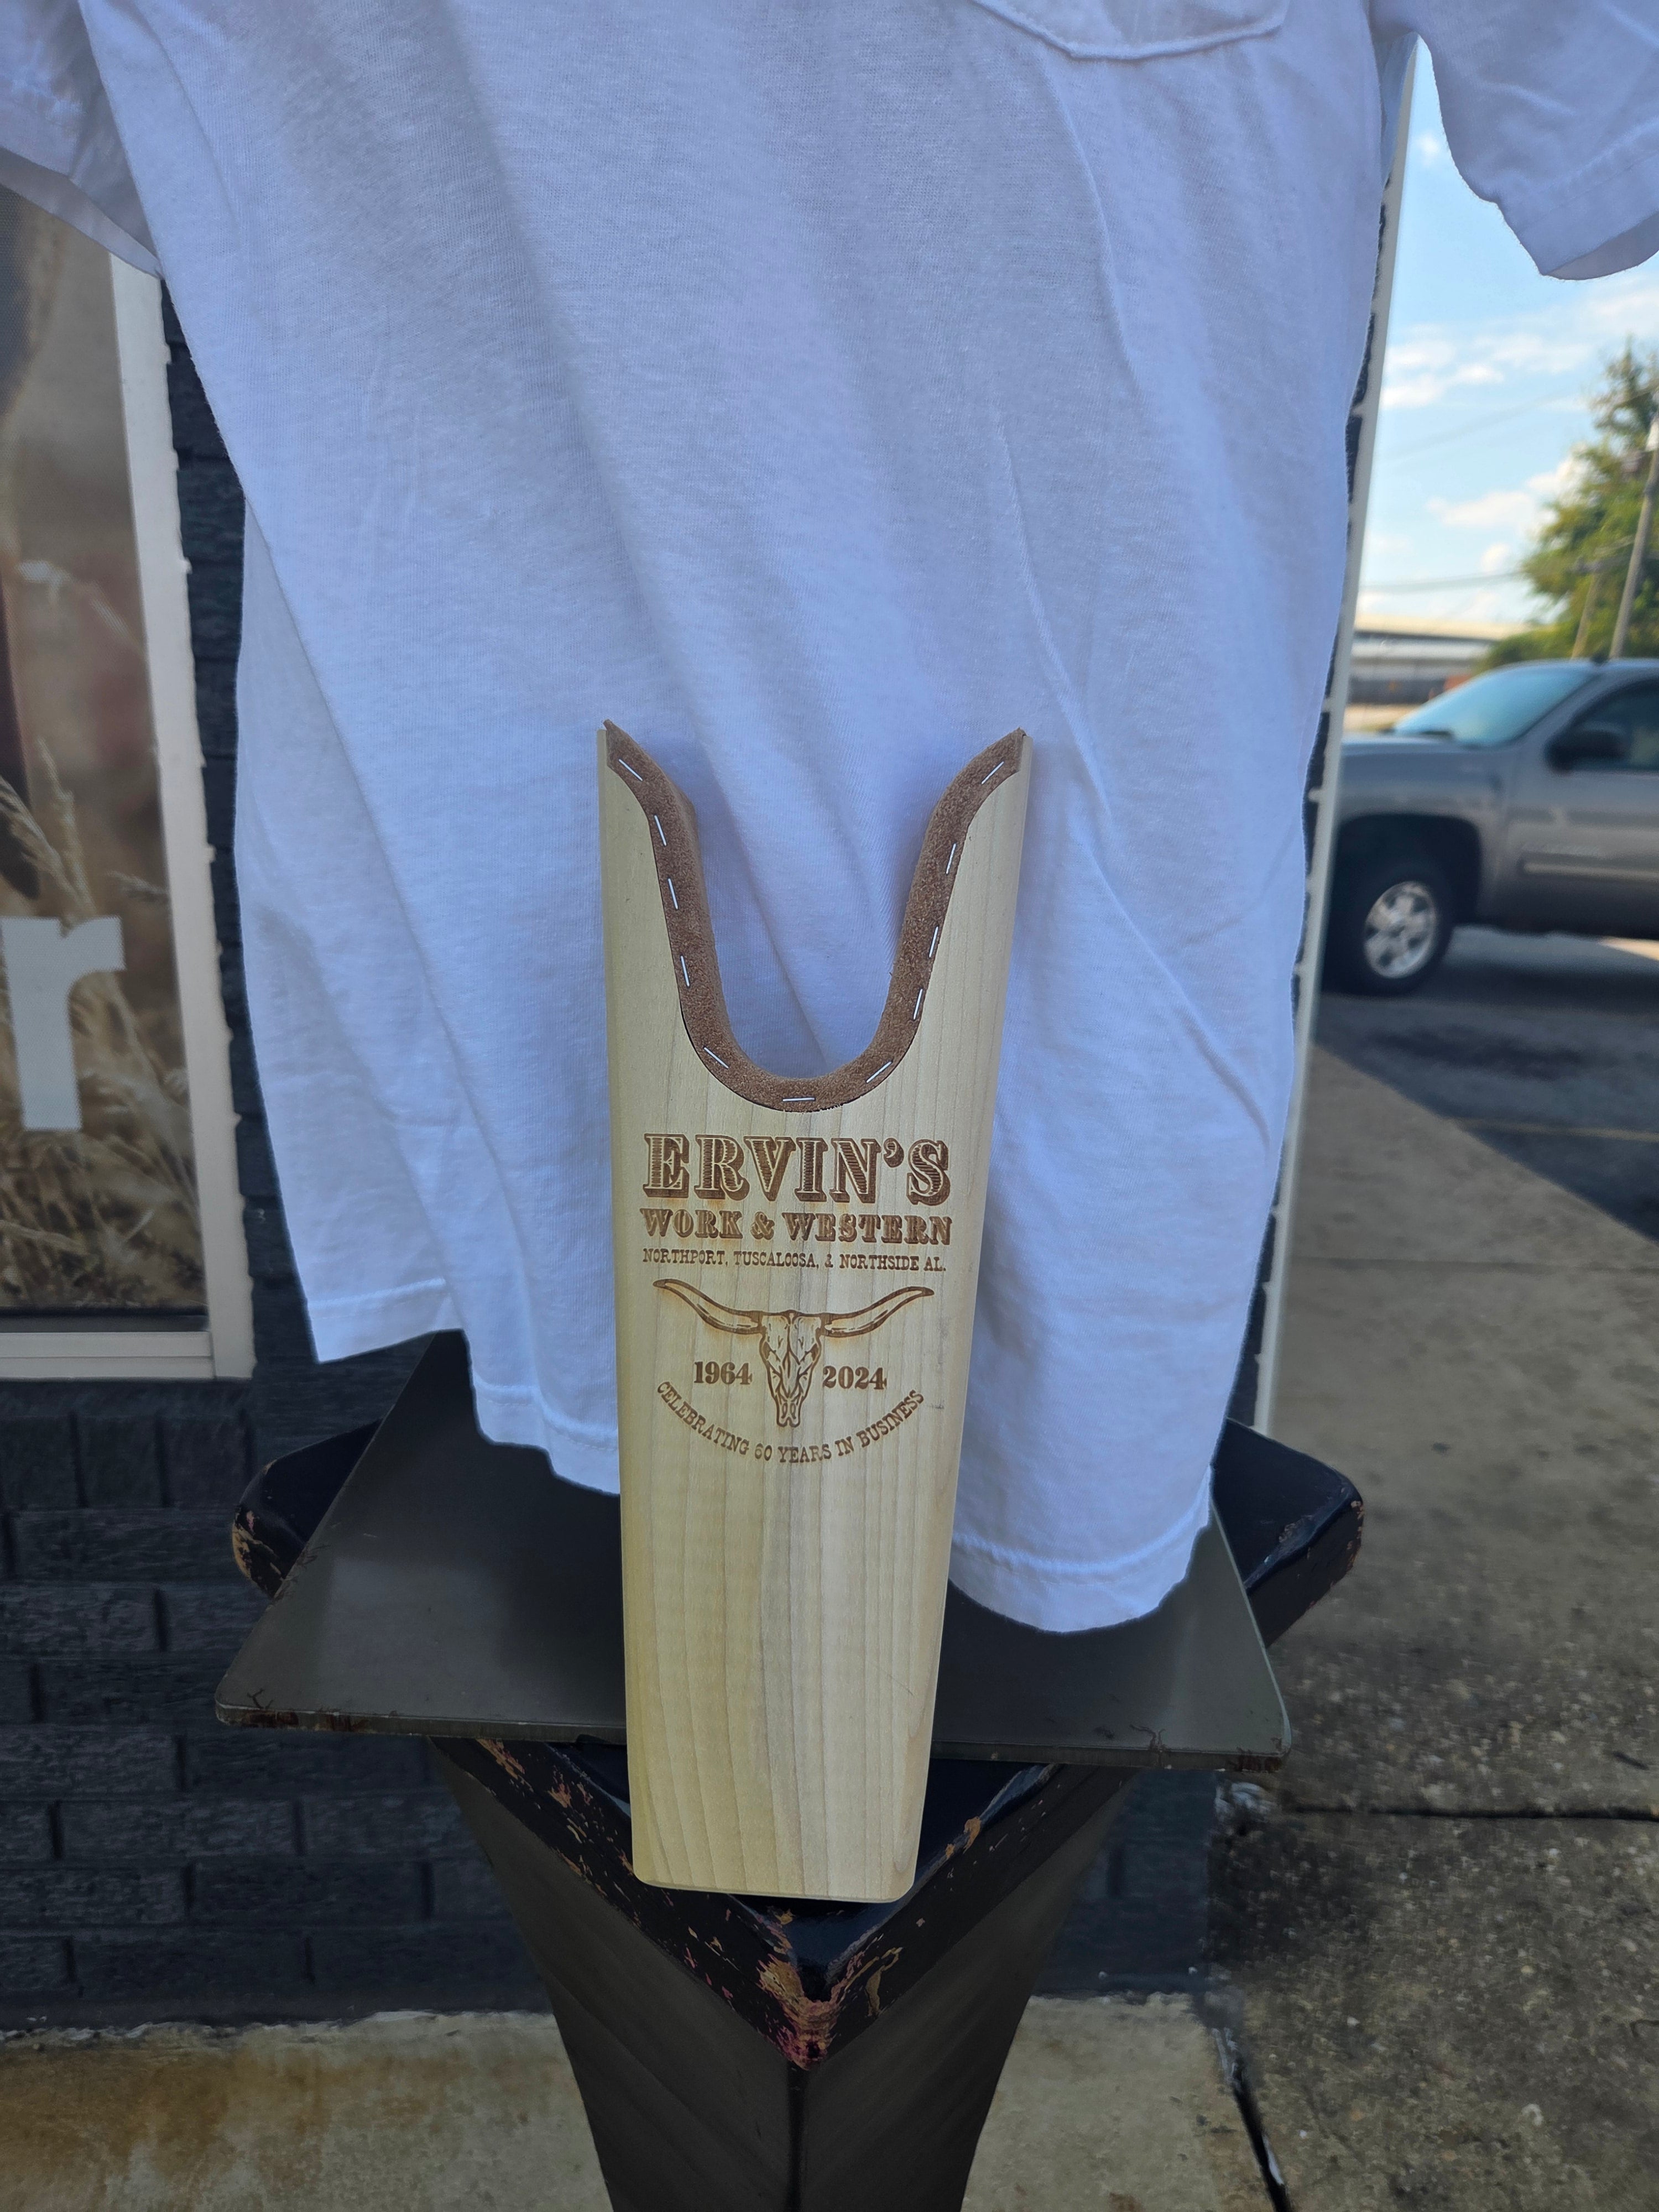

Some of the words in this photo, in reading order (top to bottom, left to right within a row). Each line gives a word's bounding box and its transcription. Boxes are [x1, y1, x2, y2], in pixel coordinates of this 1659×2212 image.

[642, 1133, 951, 1206] ERVIN'S
[640, 1208, 743, 1239] WORK
[750, 1211, 774, 1240] &
[781, 1212, 952, 1245] WESTERN
[642, 1248, 728, 1265] NORTHPORT,
[733, 1251, 819, 1269] TUSCALOOSA,
[825, 1253, 833, 1268] &
[839, 1254, 919, 1271] NORTHSIDE
[693, 1361, 753, 1385] 1964
[822, 1365, 887, 1390] 2024
[656, 1381, 749, 1457] CELEBRATING
[754, 1443, 773, 1462] 60
[779, 1443, 832, 1463] YEARS
[833, 1436, 855, 1457] IN
[857, 1390, 925, 1448] BUSINESS
